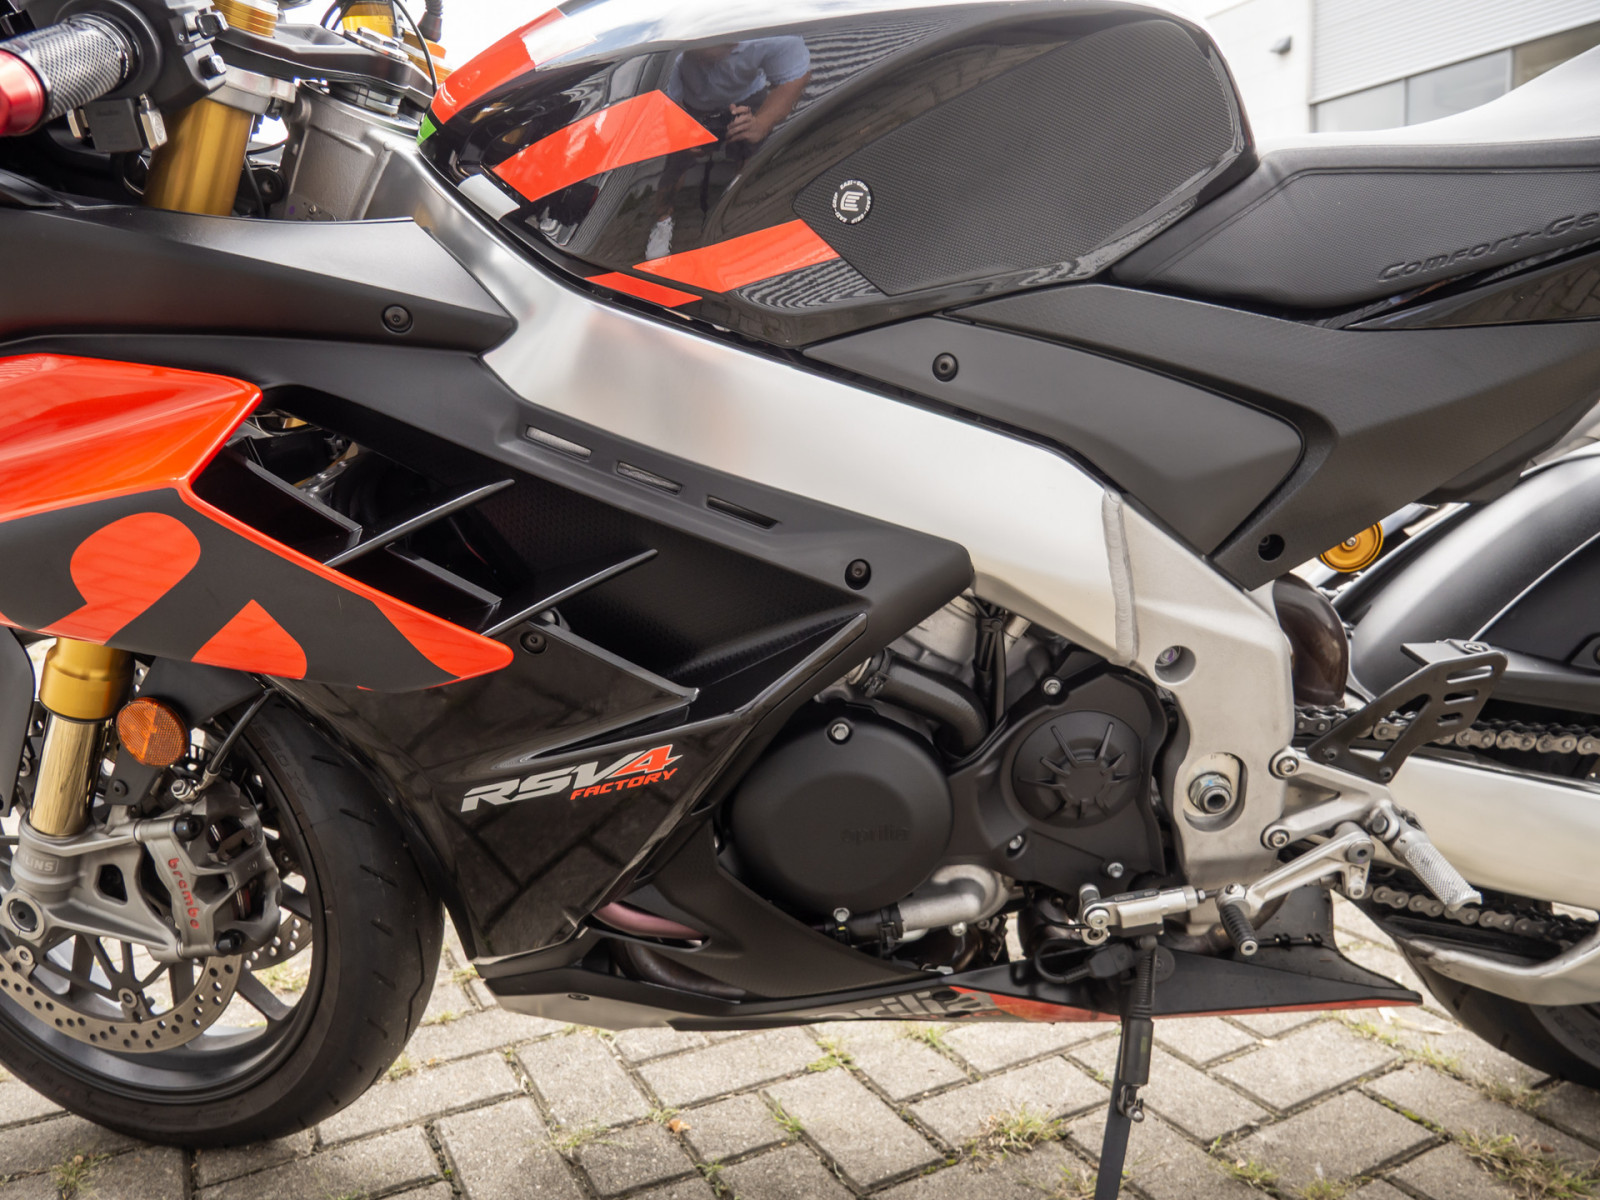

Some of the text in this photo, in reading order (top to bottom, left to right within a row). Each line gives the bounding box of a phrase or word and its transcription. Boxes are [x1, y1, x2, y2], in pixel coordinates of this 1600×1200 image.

[461, 744, 683, 813] RSV4
[569, 767, 678, 801] FACTORY
[20, 852, 54, 872] LINS
[168, 857, 200, 930] brembo
